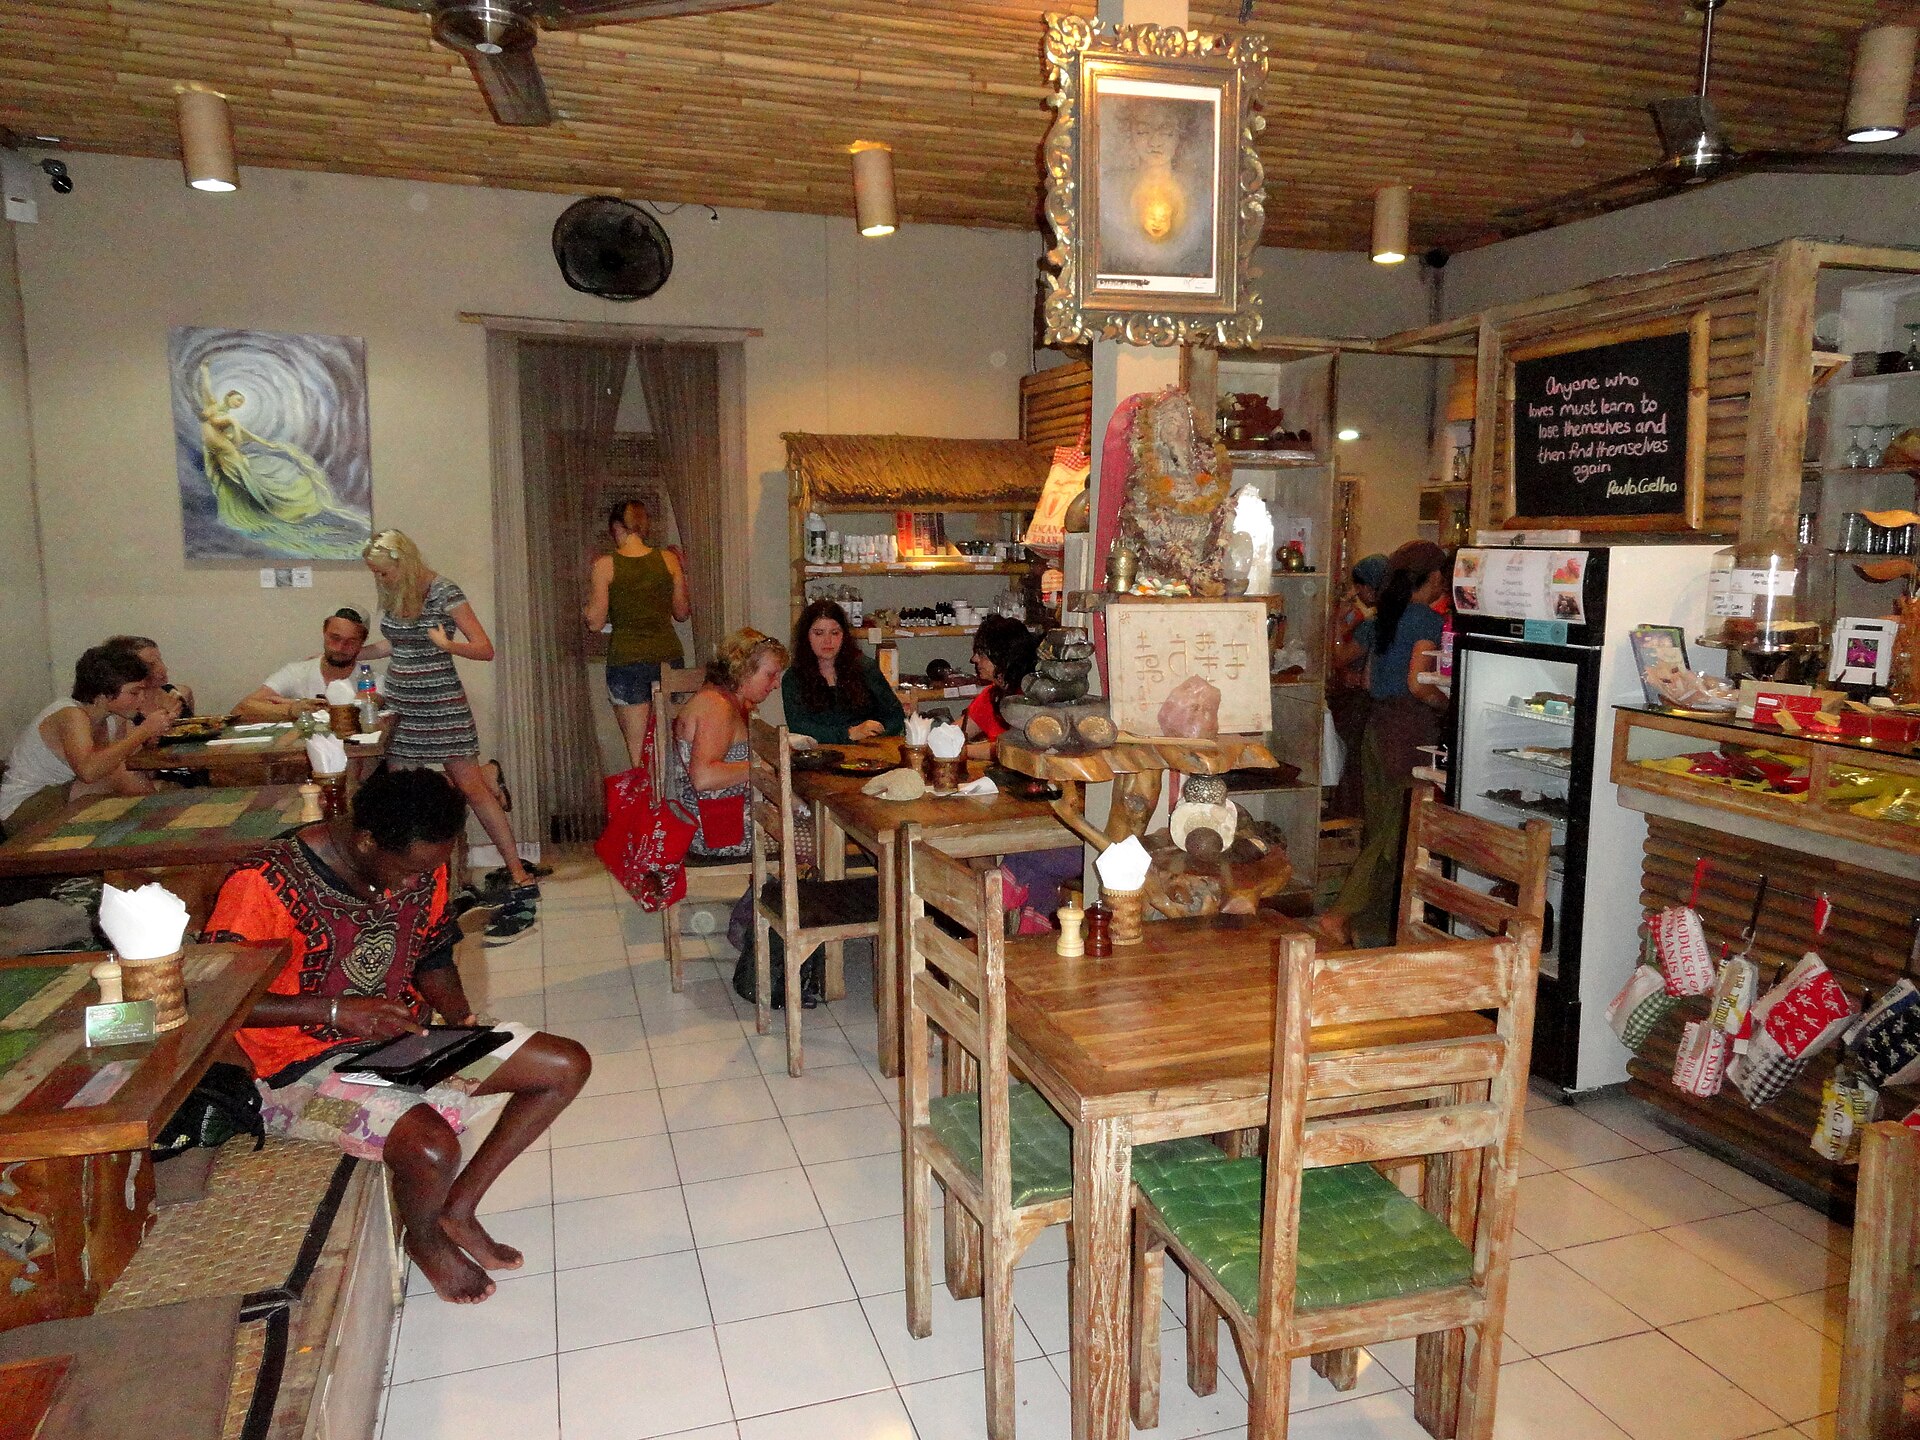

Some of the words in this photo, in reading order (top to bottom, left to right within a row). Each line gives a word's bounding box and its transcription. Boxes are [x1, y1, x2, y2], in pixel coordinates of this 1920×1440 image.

[1545, 376, 1600, 401] Anyone
[1605, 372, 1639, 388] who
[1528, 402, 1554, 417] loves
[1559, 398, 1598, 416] must
[1600, 398, 1635, 415] learn
[1640, 392, 1658, 414] to
[1538, 423, 1560, 439] lose
[1563, 418, 1631, 437] themselves
[1635, 412, 1667, 435] and
[1537, 445, 1565, 464] then
[1569, 441, 1594, 460] find
[1595, 436, 1669, 456] themselves
[1573, 459, 1611, 483] again
